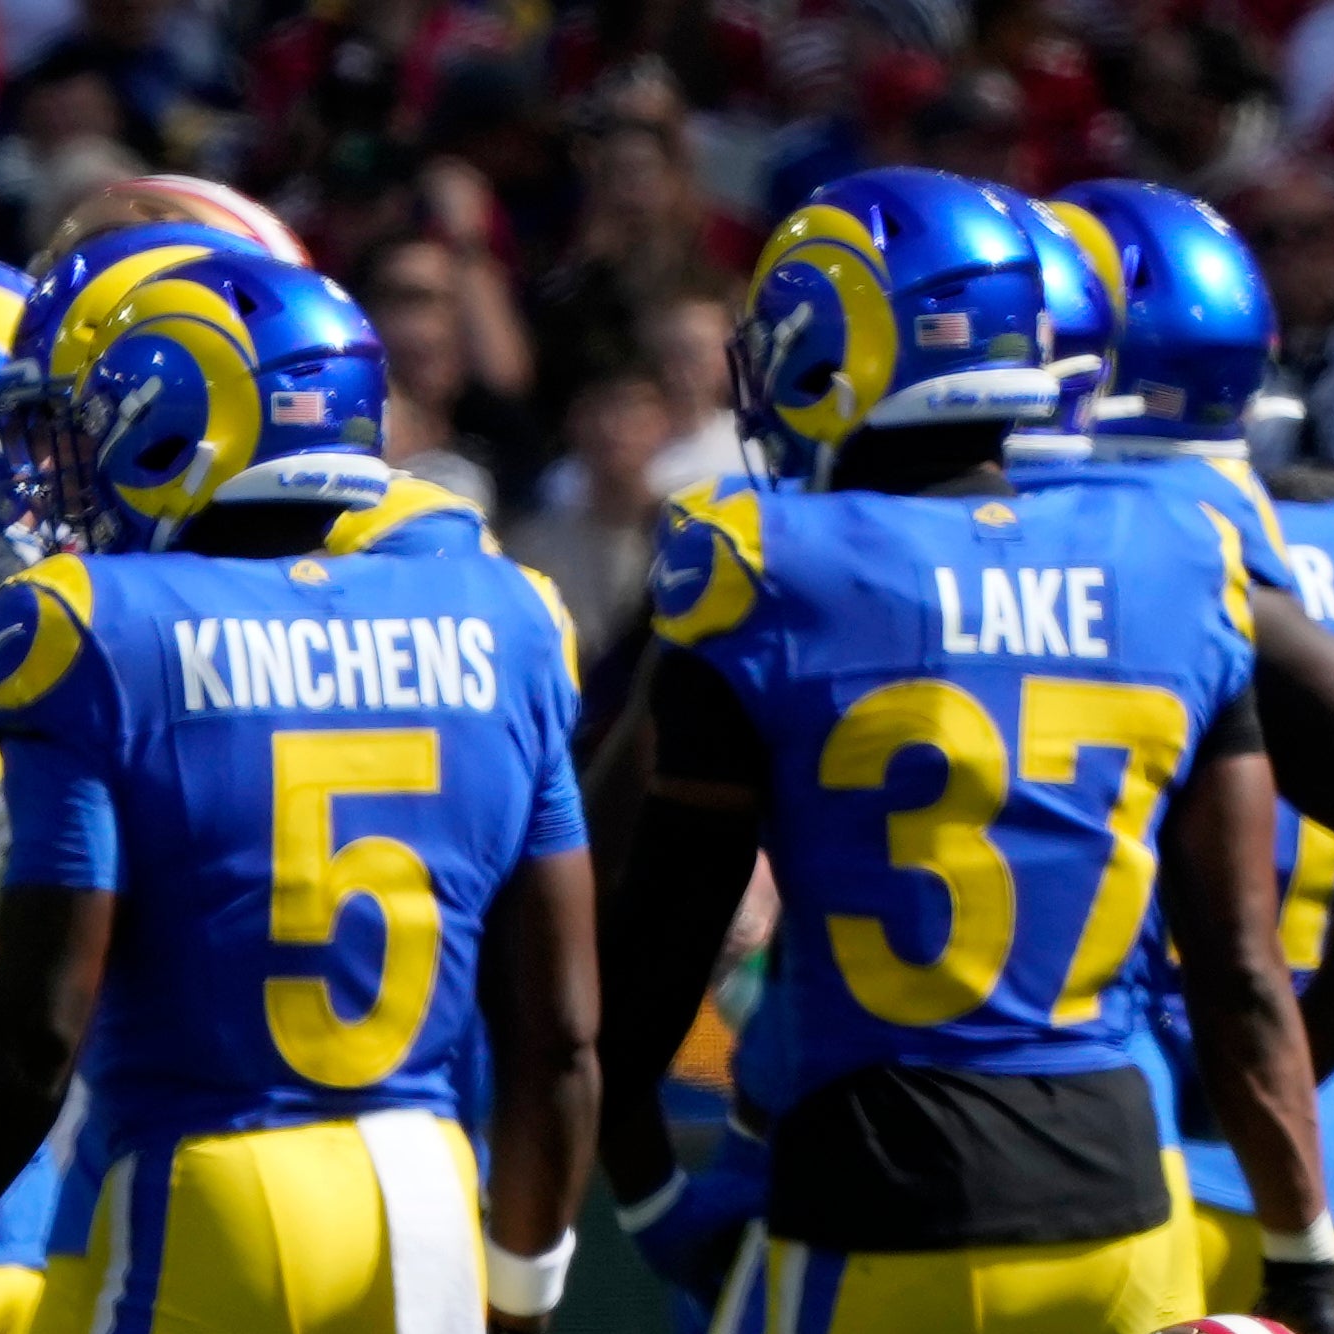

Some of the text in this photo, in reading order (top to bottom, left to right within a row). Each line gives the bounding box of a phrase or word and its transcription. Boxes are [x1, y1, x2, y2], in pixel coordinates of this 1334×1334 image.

[172, 615, 498, 712] KINCHENS
[934, 566, 1110, 659] LAKE
[265, 729, 440, 1089] 5
[820, 677, 1187, 1026] 37
